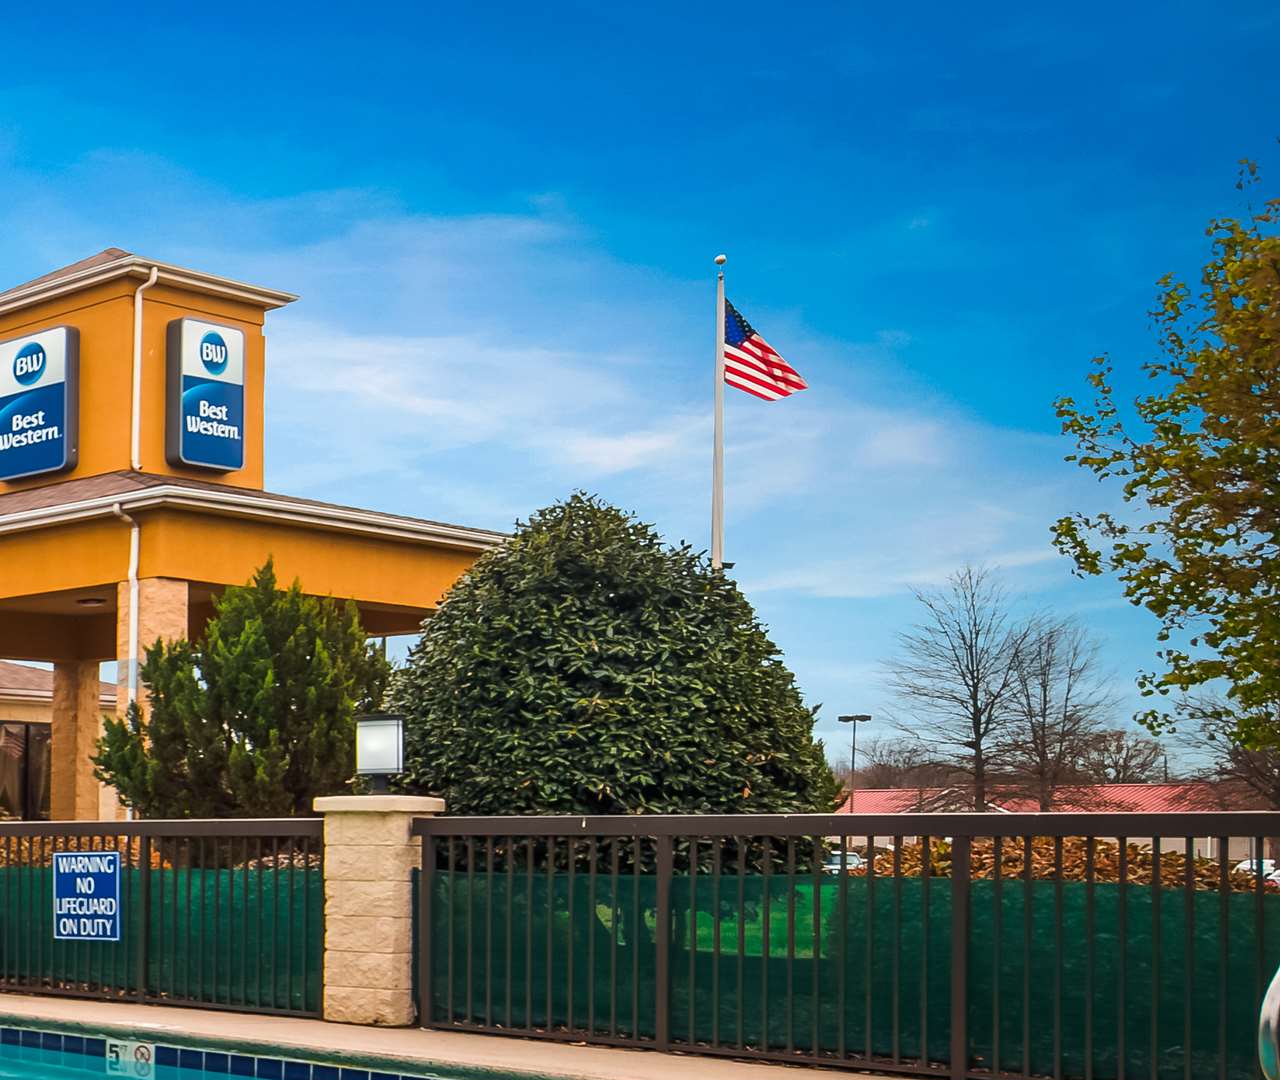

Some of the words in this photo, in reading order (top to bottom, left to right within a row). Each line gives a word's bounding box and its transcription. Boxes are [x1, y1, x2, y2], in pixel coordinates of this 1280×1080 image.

[203, 342, 226, 364] BW
[15, 352, 44, 377] BW
[12, 410, 46, 432] Best
[199, 400, 228, 421] Best
[186, 415, 240, 440] Western
[58, 856, 115, 873] WARNING
[76, 877, 95, 894] NO
[56, 898, 116, 915] LIFEGUARD
[60, 918, 78, 935] ON
[80, 919, 113, 936] DUTY
